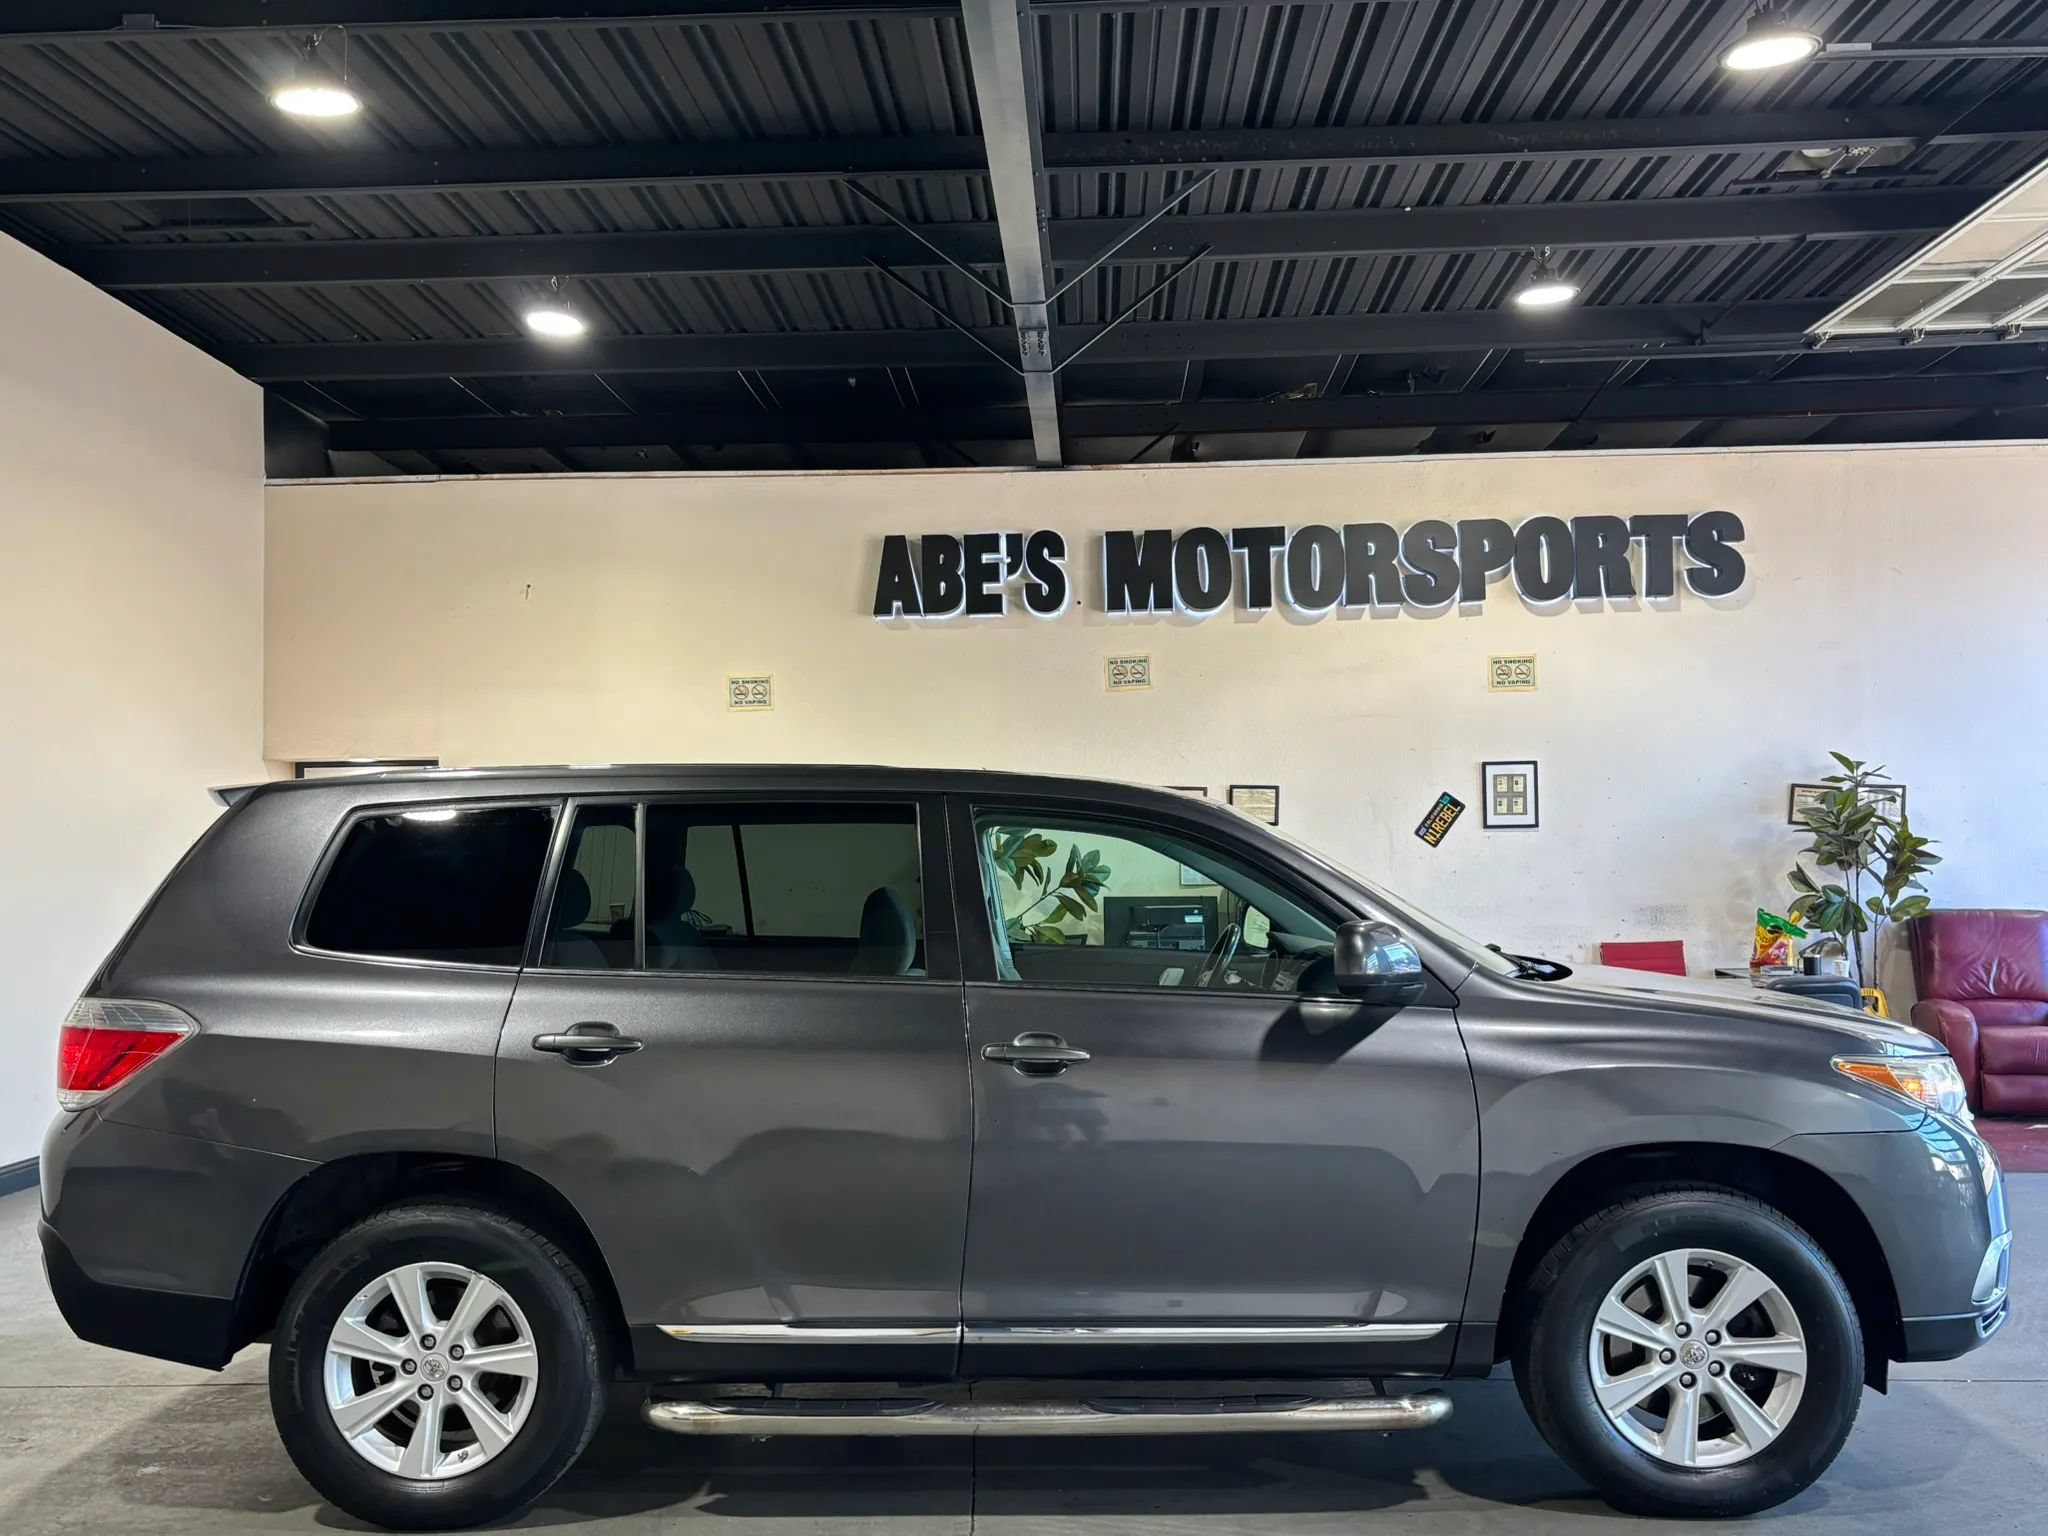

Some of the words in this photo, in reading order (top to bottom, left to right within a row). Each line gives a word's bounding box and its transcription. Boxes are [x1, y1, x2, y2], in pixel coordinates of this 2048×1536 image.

[873, 529, 1068, 618] ABE'S
[1103, 510, 1747, 615] MOTORSPORTS
[1424, 802, 1443, 828] CALIFORNIA
